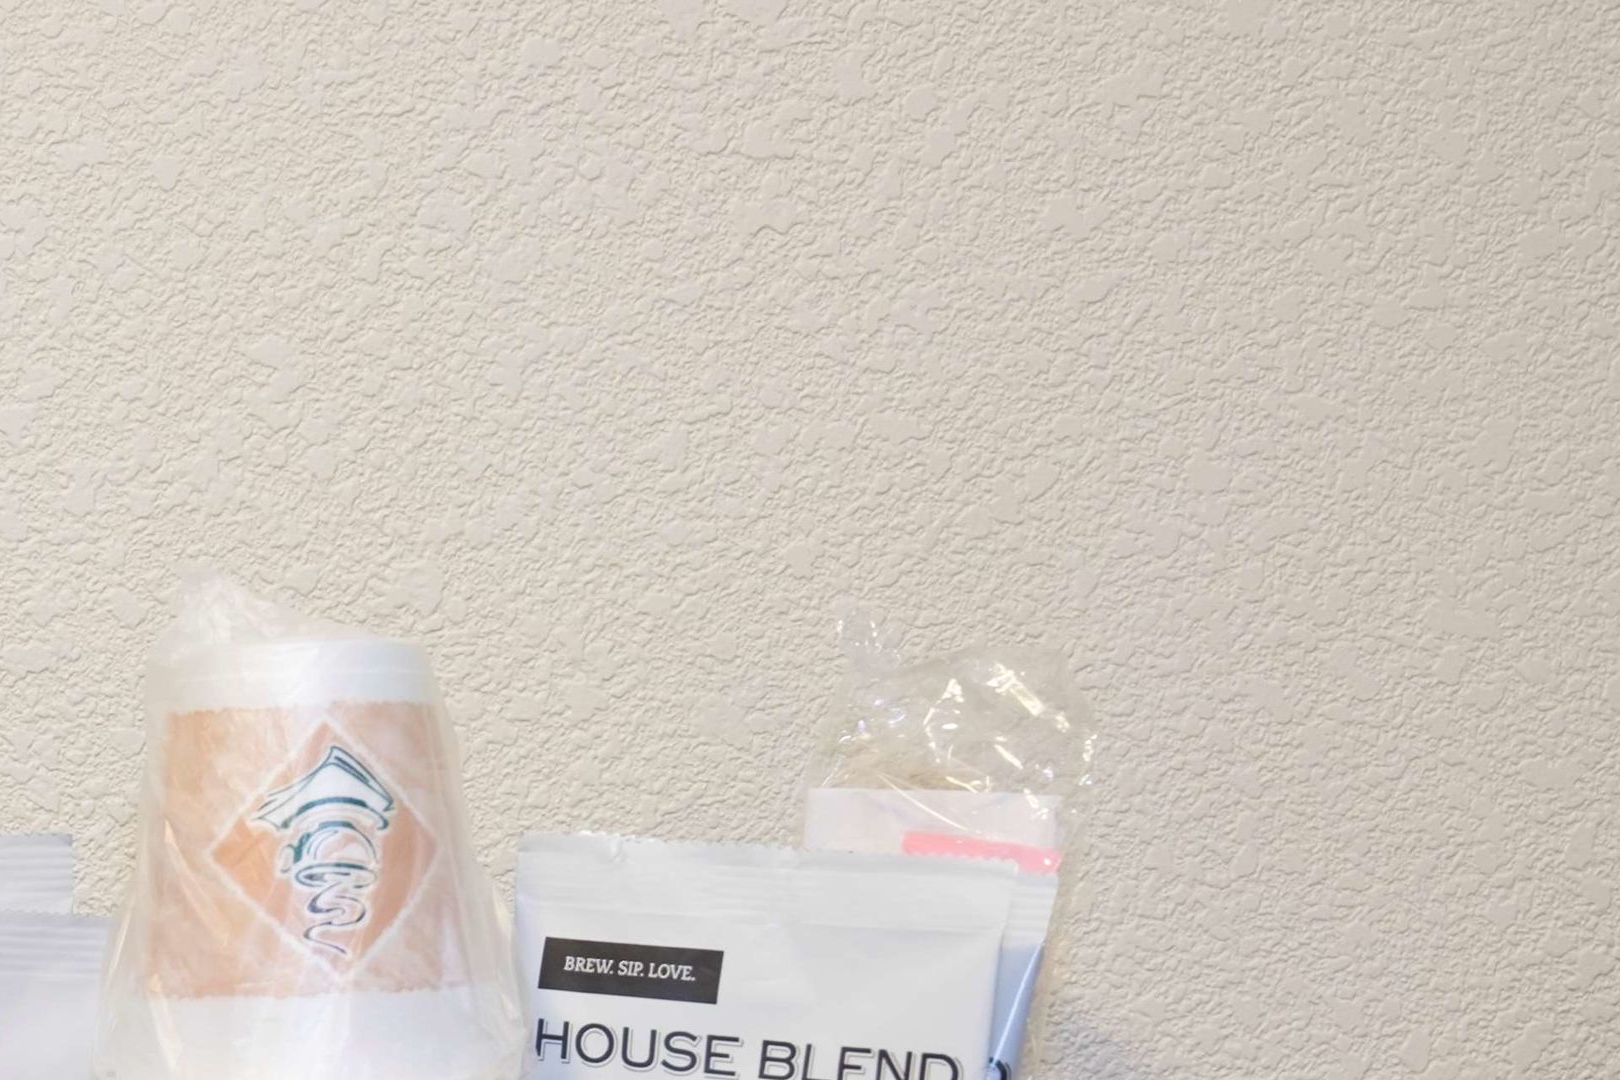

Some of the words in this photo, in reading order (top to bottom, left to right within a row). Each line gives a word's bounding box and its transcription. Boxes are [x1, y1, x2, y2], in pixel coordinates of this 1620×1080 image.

[563, 955, 614, 974] BREW.
[617, 960, 644, 977] SIP.
[648, 962, 696, 981] LOVE.
[535, 1018, 744, 1080] HOUSE
